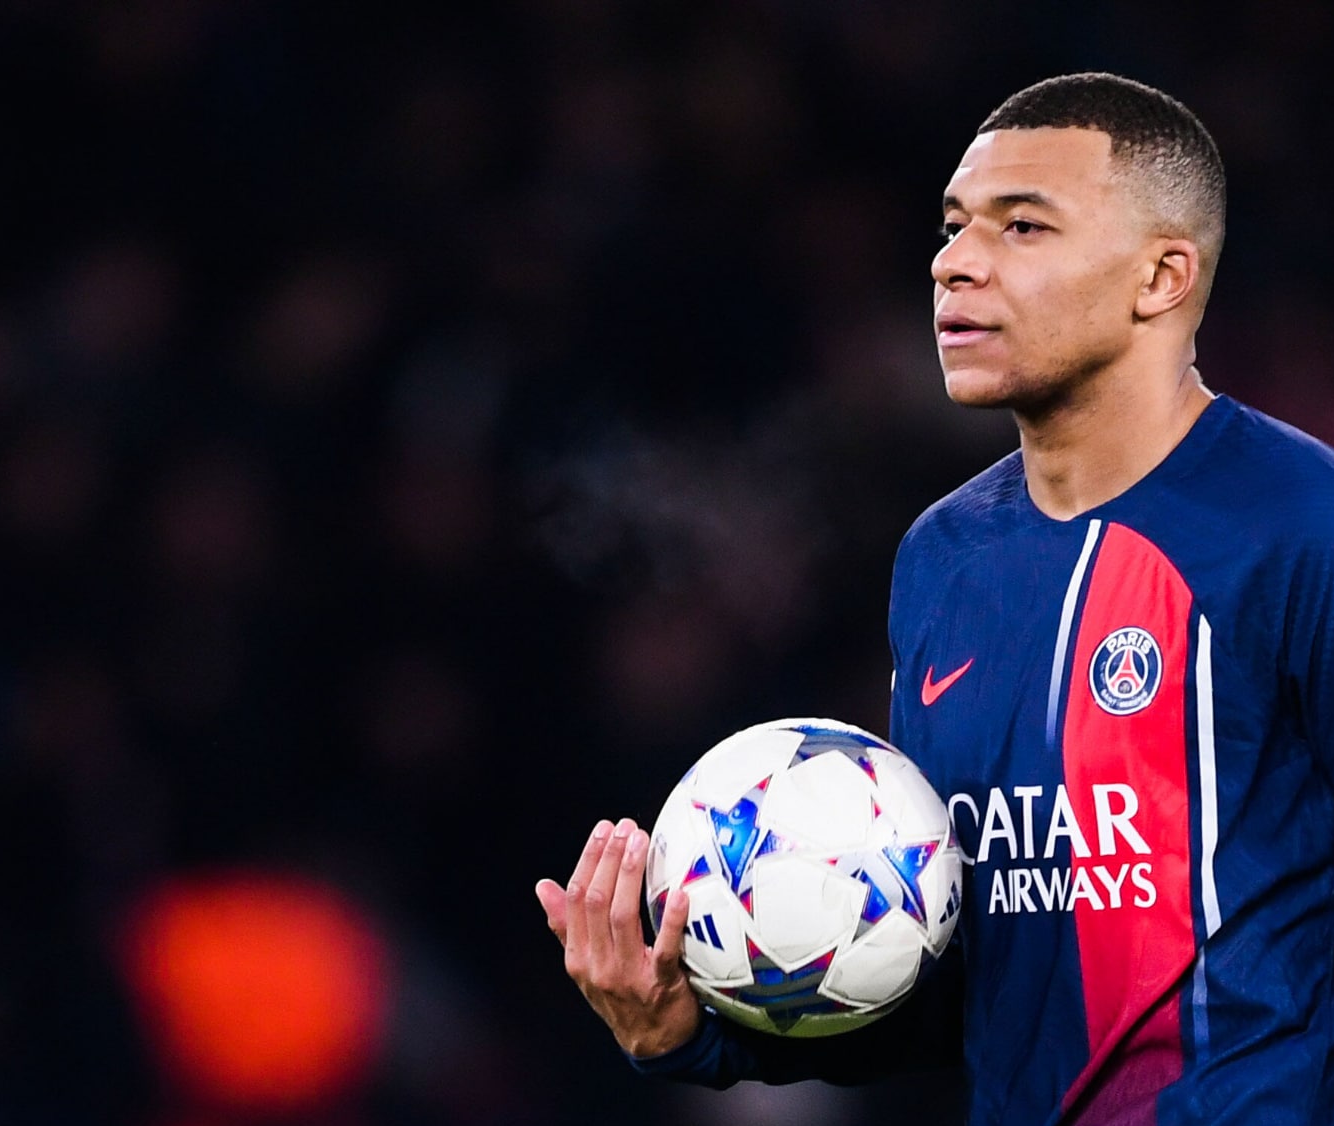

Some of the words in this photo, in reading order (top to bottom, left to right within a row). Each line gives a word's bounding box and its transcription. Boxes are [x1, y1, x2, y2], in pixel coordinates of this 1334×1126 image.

[1105, 631, 1152, 654] PARIS
[948, 783, 1152, 866] QATAR
[988, 862, 1157, 914] AIRWAYS
